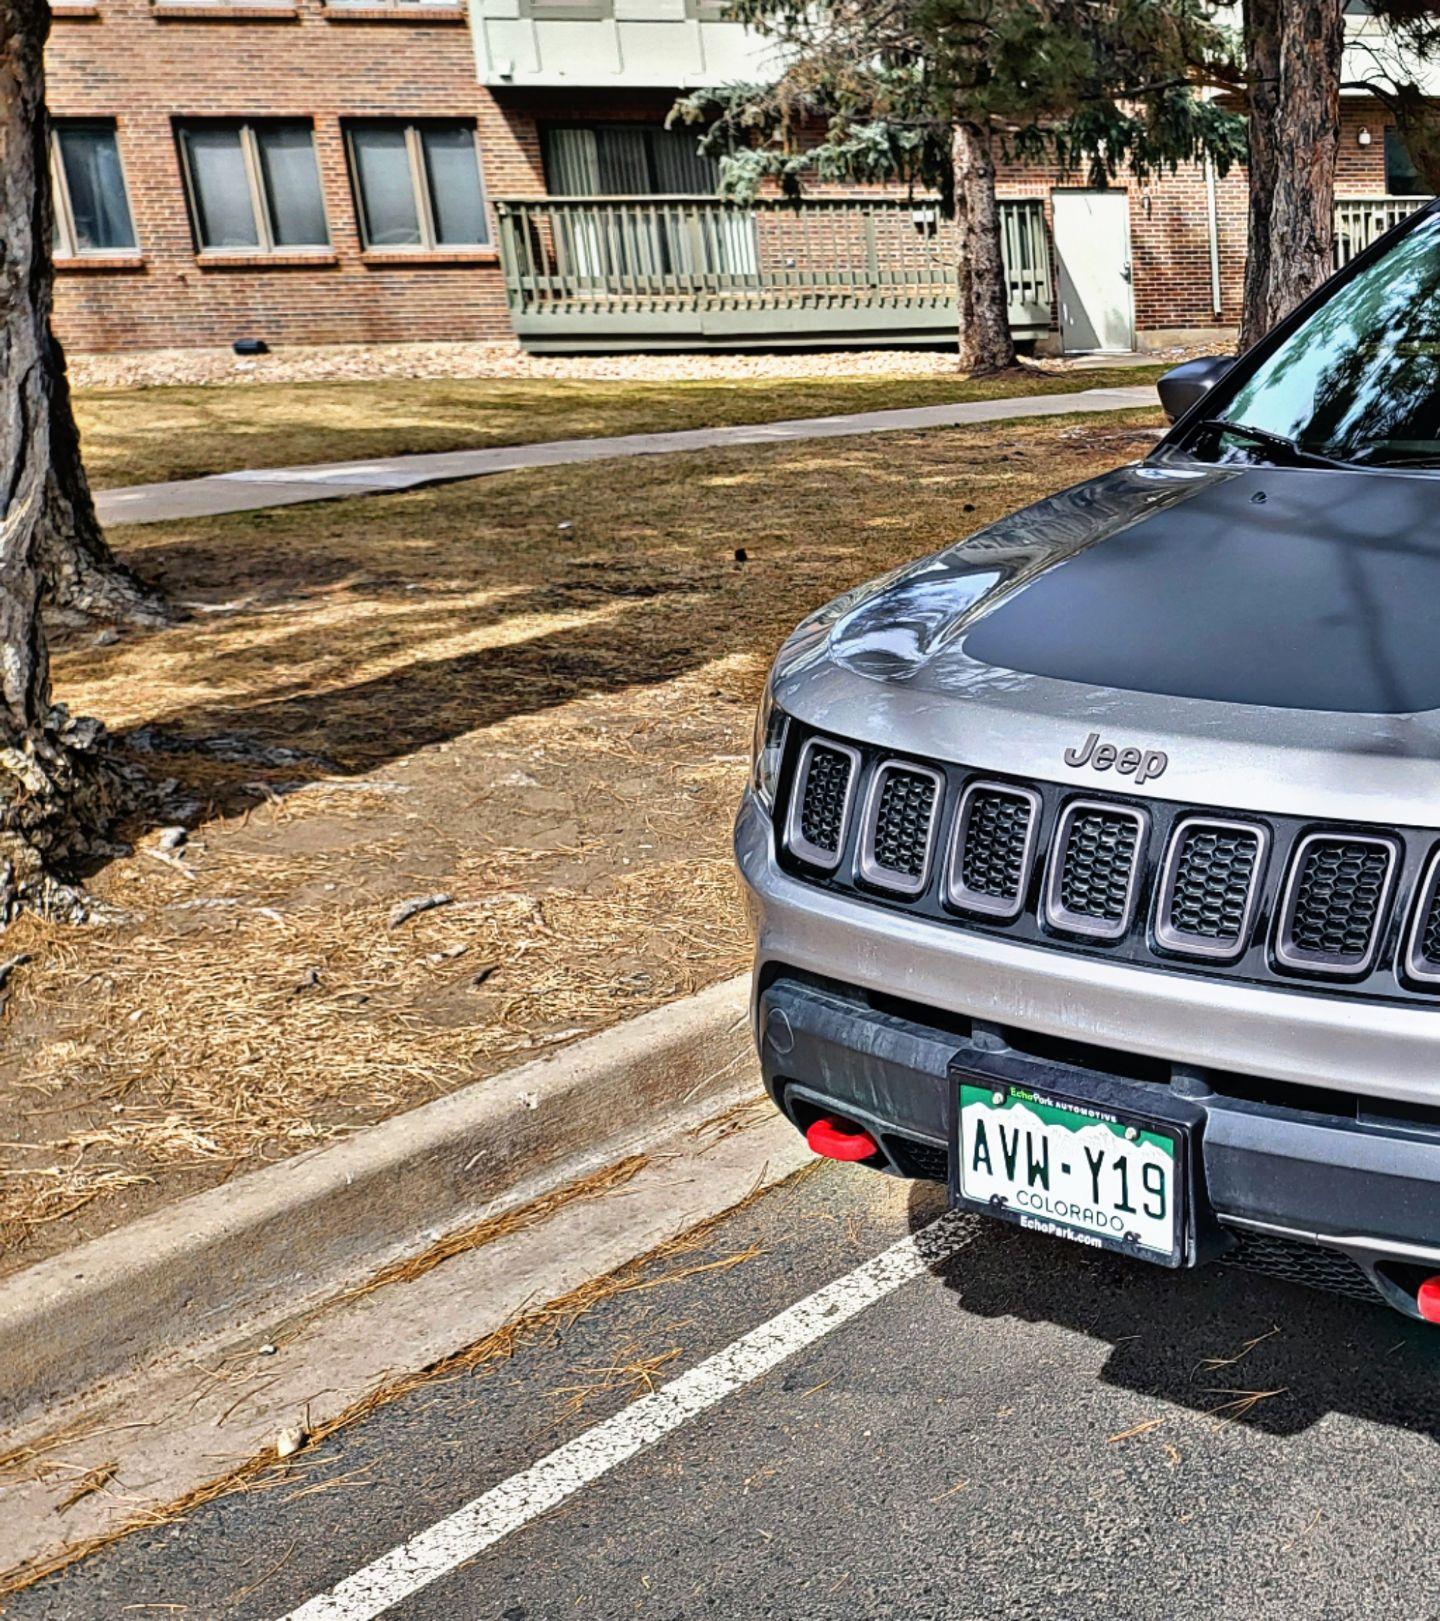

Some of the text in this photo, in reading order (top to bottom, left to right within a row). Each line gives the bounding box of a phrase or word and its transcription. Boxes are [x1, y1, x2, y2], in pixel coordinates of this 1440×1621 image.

[1064, 733, 1168, 785] Jeep
[1010, 1086, 1117, 1123] EchoPark AUTOMOTIVE
[1016, 1190, 1124, 1231] COLORADO
[1020, 1216, 1102, 1248] EchoPark.com
